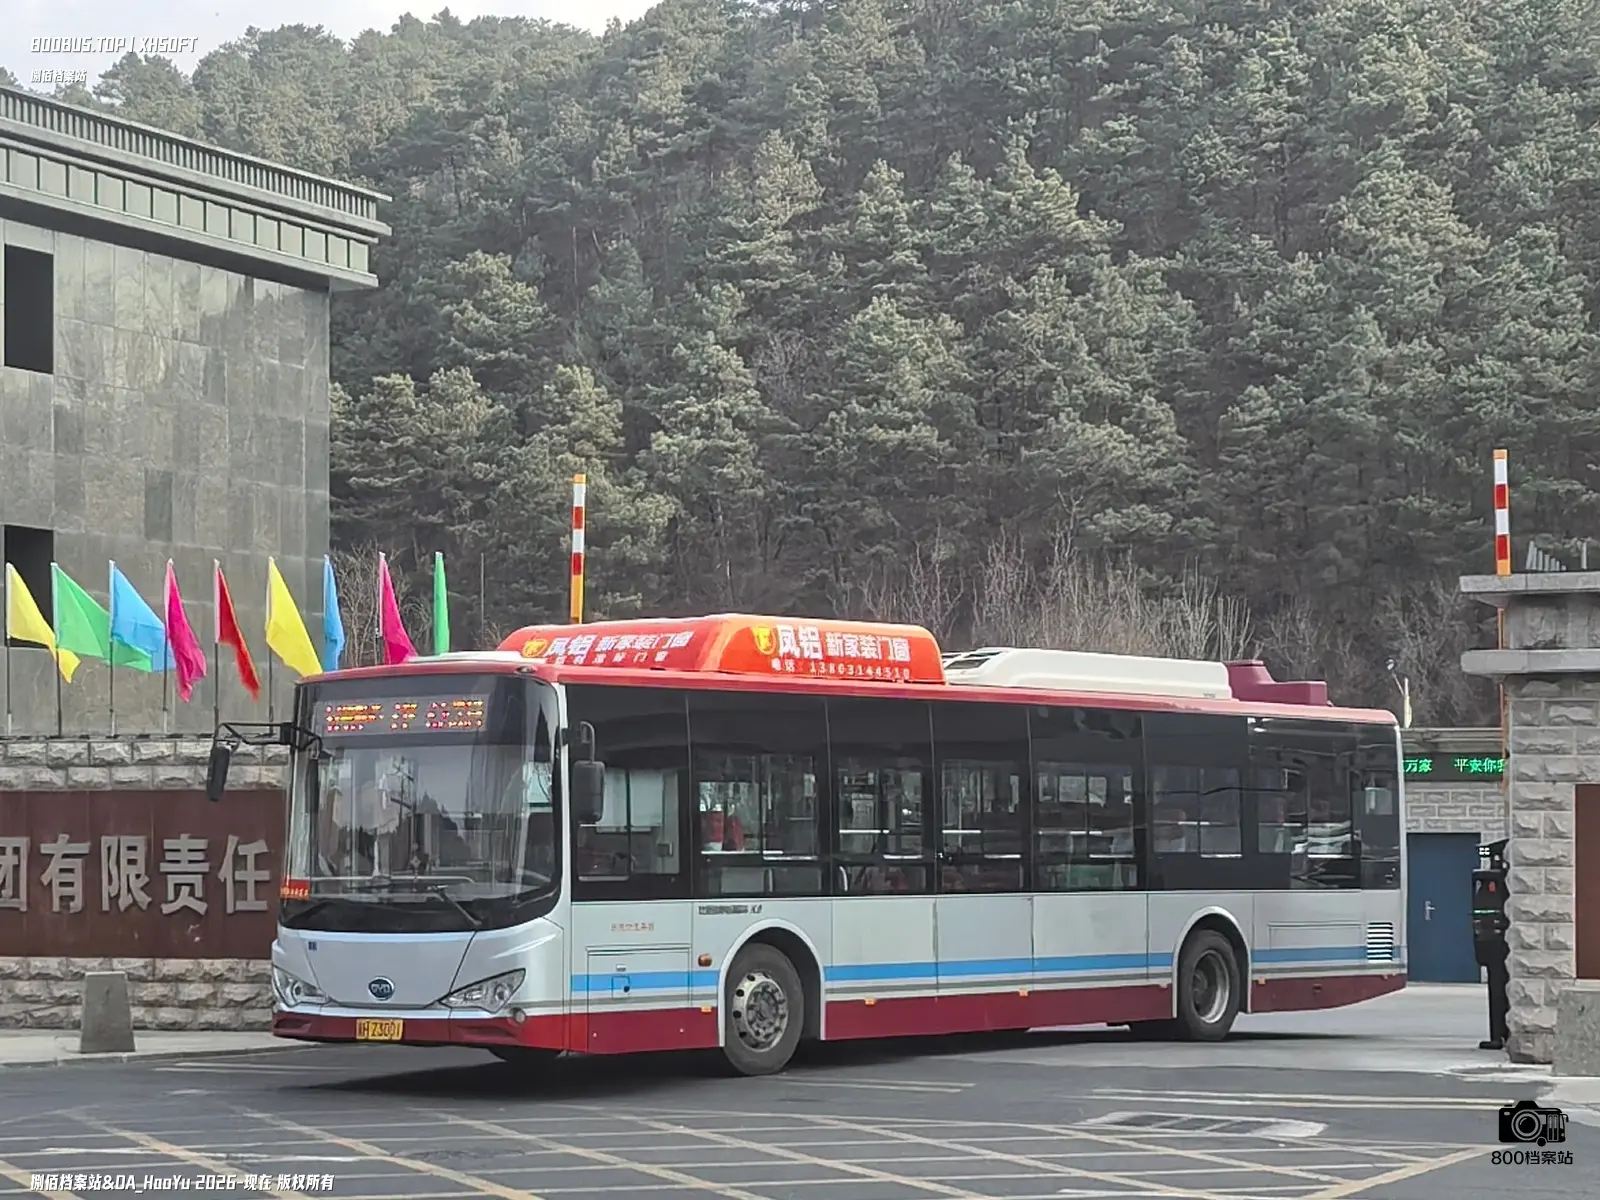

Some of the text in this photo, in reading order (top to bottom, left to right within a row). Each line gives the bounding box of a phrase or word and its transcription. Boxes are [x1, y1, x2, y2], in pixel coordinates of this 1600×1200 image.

[825, 631, 911, 662] 新家装门窗
